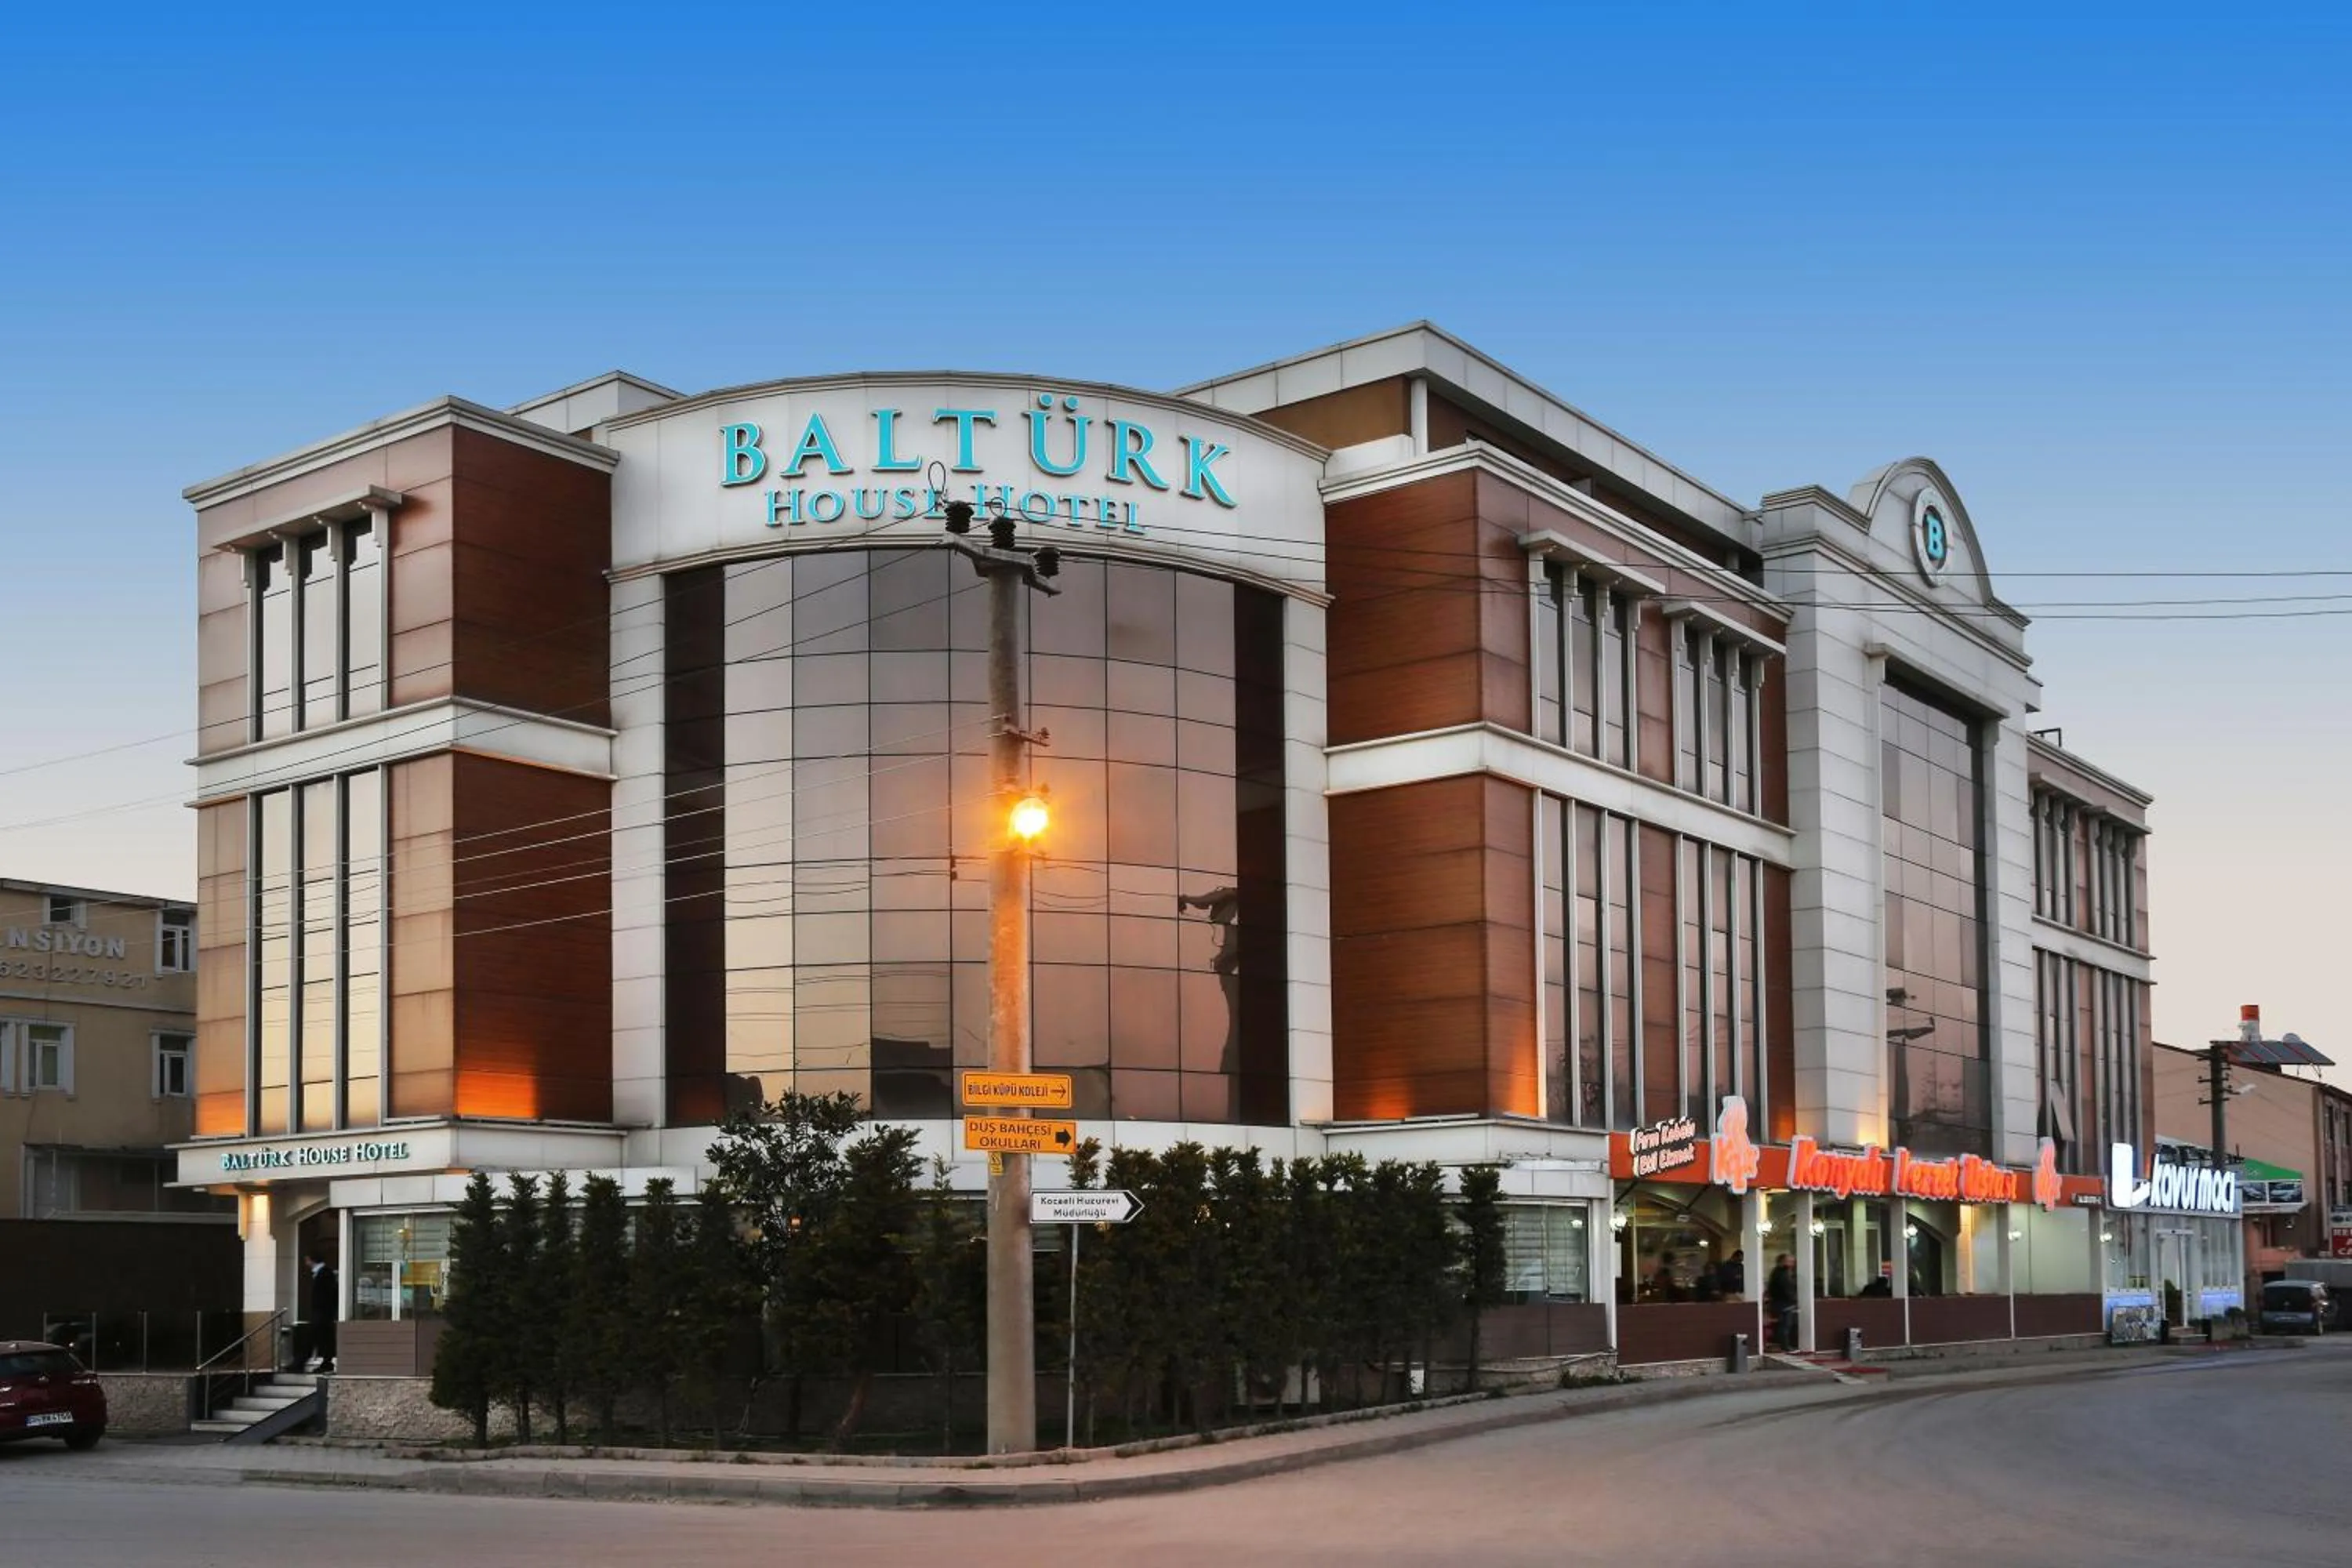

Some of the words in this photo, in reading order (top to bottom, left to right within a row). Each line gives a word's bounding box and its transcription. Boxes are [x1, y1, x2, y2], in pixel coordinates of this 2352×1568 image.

[720, 393, 1236, 509] BALTÜRK
[764, 488, 946, 527] HOUSE
[969, 483, 1145, 535] HOTEL
[1927, 514, 1944, 559] B
[0, 924, 125, 960] NSİYON
[967, 1082, 992, 1097] BİLGİ
[993, 1083, 1017, 1097] KÜPÜ
[1018, 1085, 1048, 1098] KOLEJİ
[969, 1121, 996, 1134] DÜŞ
[1000, 1123, 1051, 1137] BAHÇESİ
[980, 1137, 1040, 1150] OKULLARI
[220, 1148, 292, 1171] BALTÜRK
[297, 1147, 349, 1165] HOUSE
[354, 1142, 408, 1160] HOTEL
[1040, 1196, 1075, 1206] Kocaeli
[1077, 1197, 1119, 1206] Huzurevi
[1054, 1208, 1106, 1218] Müdürlüğü
